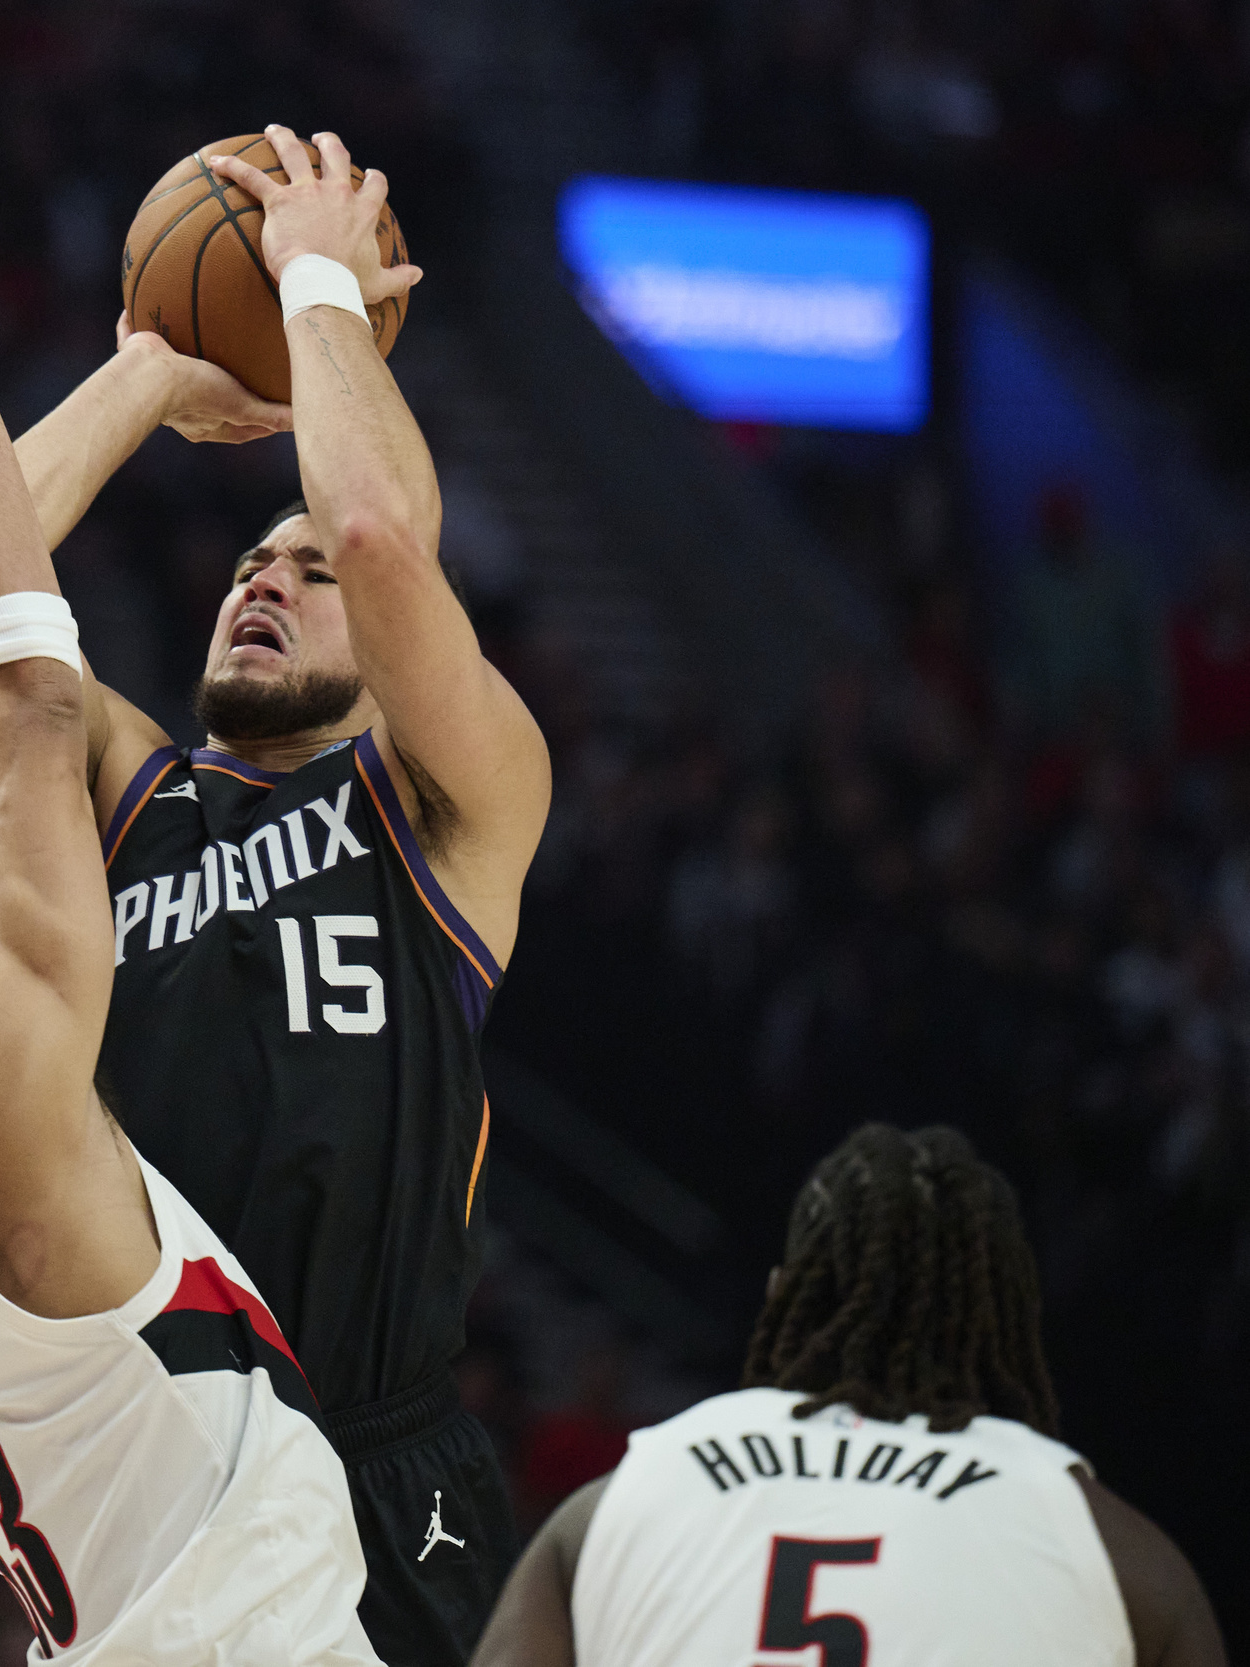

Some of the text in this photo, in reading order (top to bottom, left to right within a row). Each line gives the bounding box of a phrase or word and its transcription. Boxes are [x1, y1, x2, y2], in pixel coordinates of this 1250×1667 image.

[114, 780, 371, 967] PHOENIX
[275, 915, 387, 1034] 15
[688, 1432, 998, 1501] HOLIDAY
[753, 1534, 883, 1667] 5
